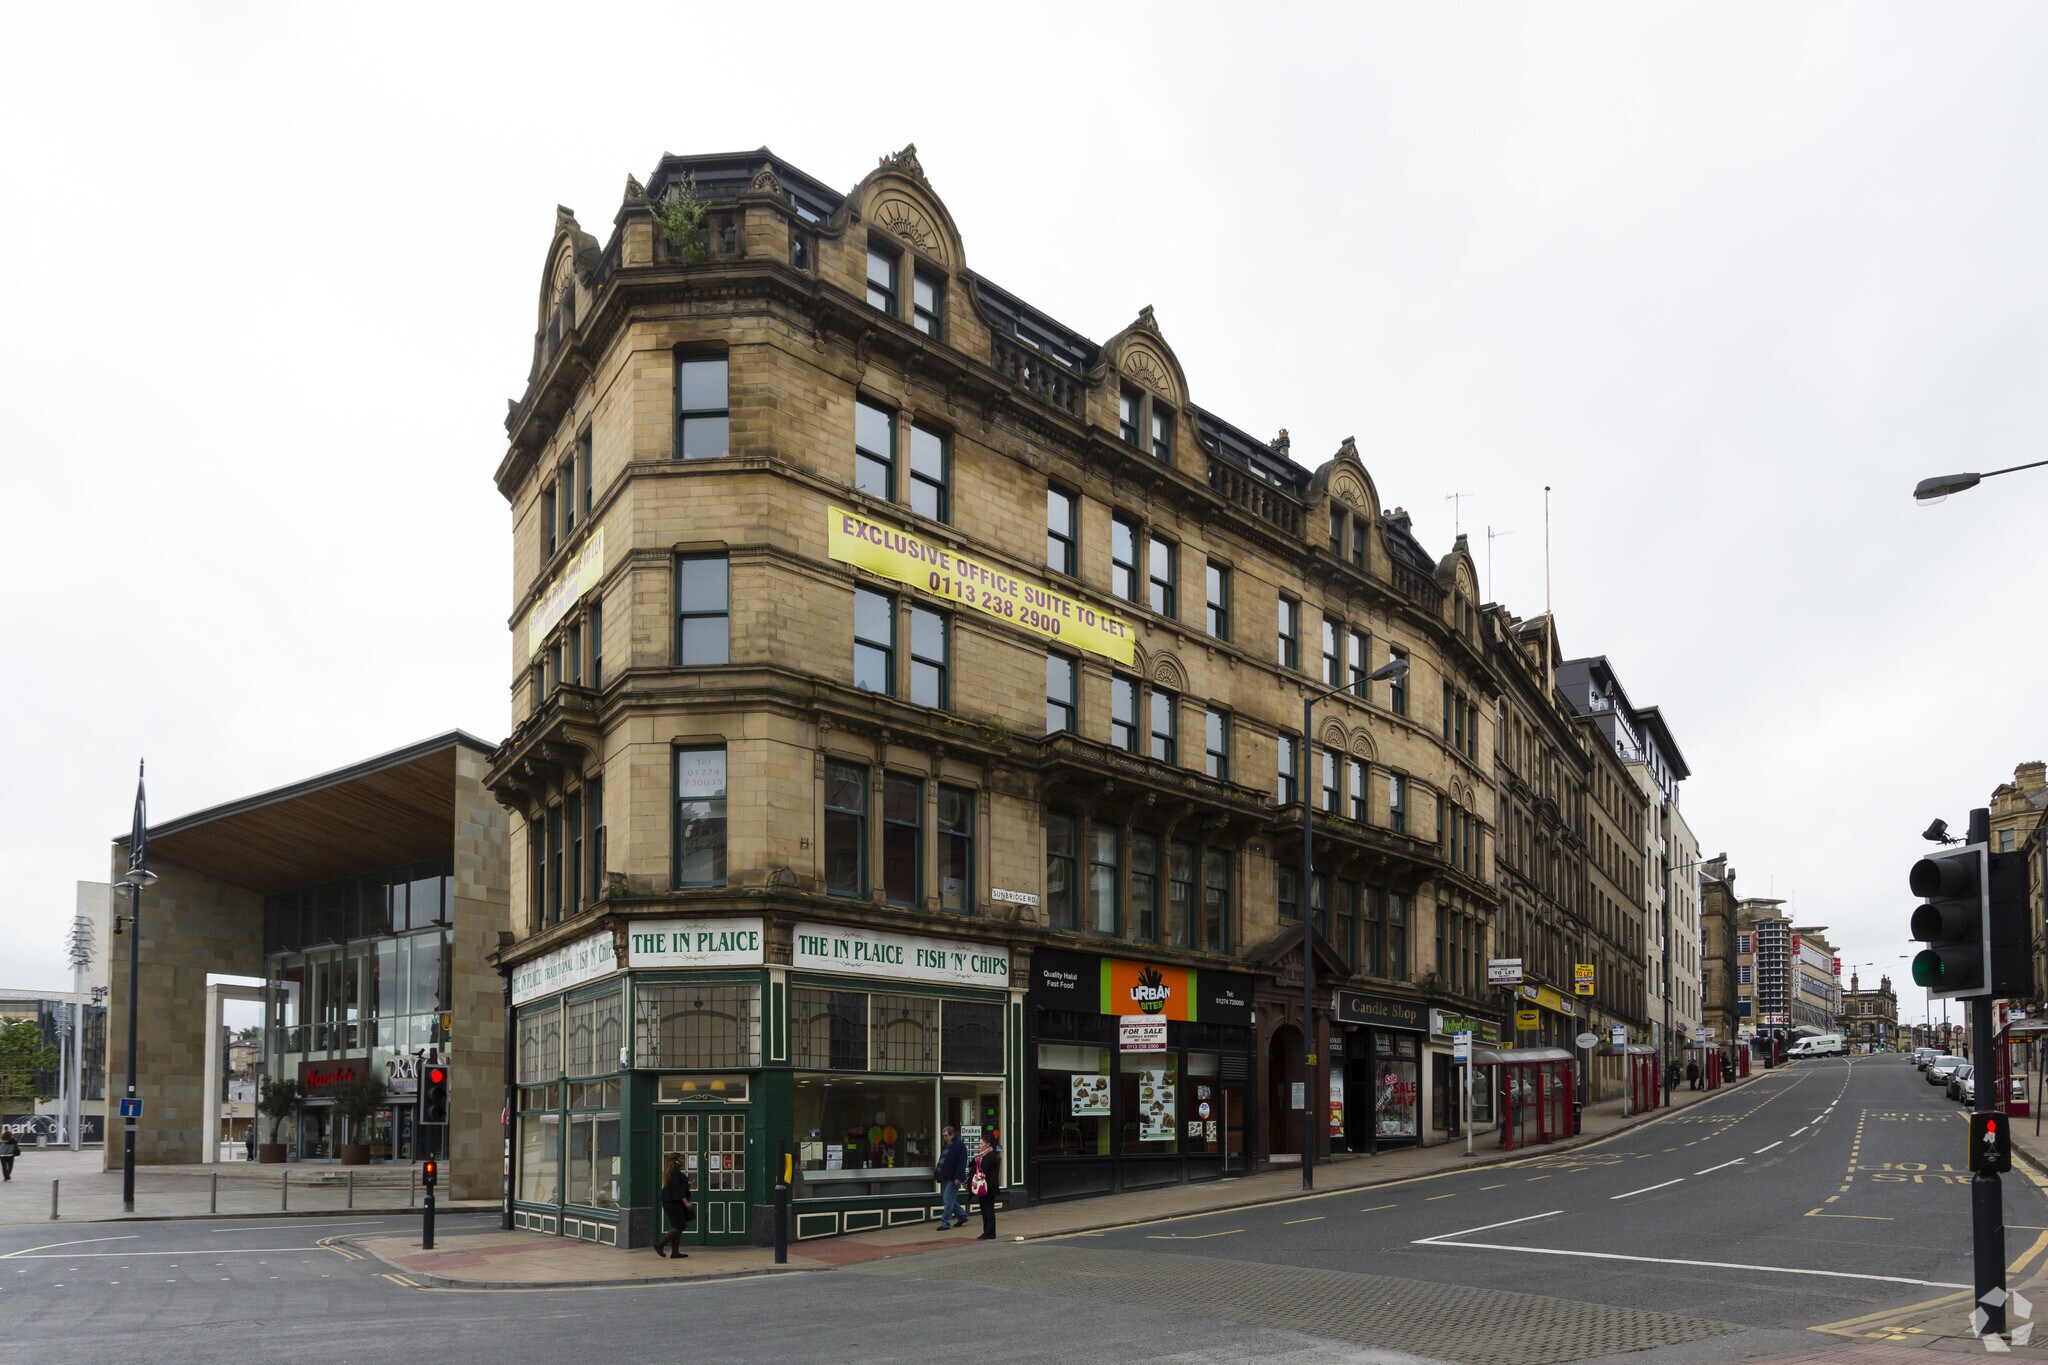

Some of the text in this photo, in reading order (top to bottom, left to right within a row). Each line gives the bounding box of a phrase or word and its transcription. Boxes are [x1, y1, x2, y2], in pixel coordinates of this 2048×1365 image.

[842, 515, 1126, 638] EXCLUSIVE OFFICE SUITE TO LET
[929, 571, 1061, 636] 0113 238 2900
[993, 890, 1026, 902] SUNBRIDGE
[632, 931, 760, 954] THE IN PLAICE
[798, 934, 1008, 976] THE IN PLAICE FISH 'N' CHIPS
[1043, 970, 1078, 981] Quality Halal
[1046, 980, 1075, 989] Fast Food
[1130, 985, 1171, 1001] URBAN
[1140, 1000, 1164, 1011] BITES
[1351, 998, 1417, 1025] Candle Shop
[306, 1066, 354, 1088] Nando's
[1385, 1073, 1398, 1086] Sale
[1393, 1081, 1416, 1094] SALE
[1857, 1162, 1970, 1172] TOP
